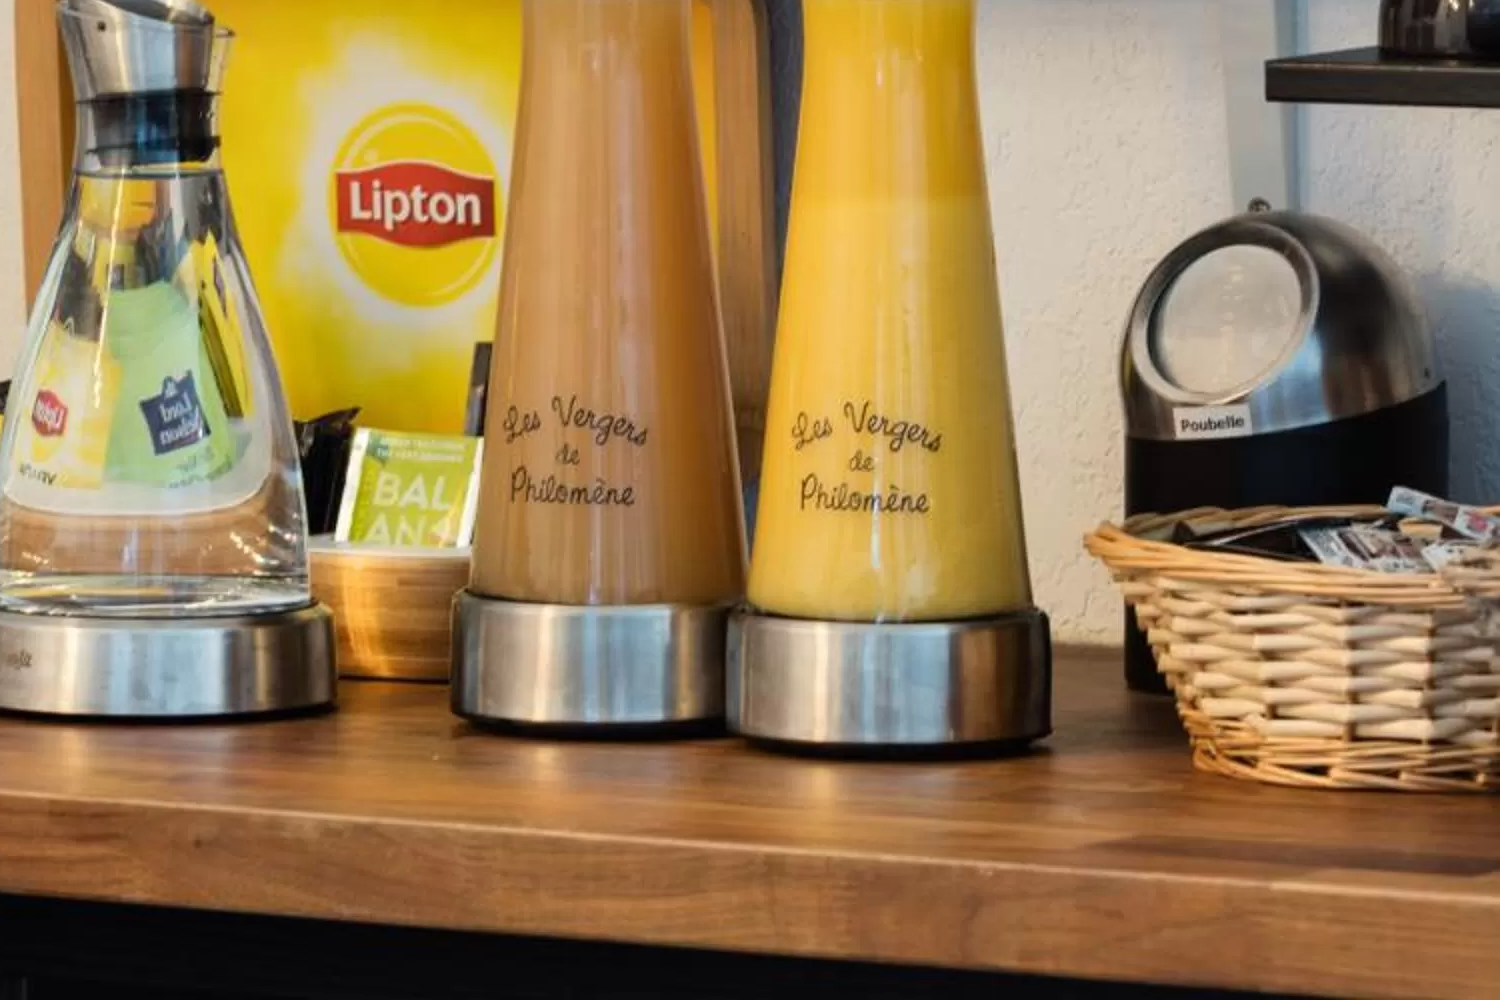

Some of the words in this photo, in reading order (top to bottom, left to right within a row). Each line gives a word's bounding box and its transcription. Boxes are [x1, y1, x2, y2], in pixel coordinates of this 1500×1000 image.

[350, 179, 482, 232] Lipton
[502, 404, 542, 445] Les
[550, 395, 648, 447] Vergers
[791, 410, 833, 451] Les
[842, 400, 943, 453] Vergers
[1180, 415, 1245, 432] Poubelle
[554, 442, 581, 466] de
[848, 449, 876, 473] de
[372, 470, 451, 511] BAL
[799, 475, 931, 515] Philomène
